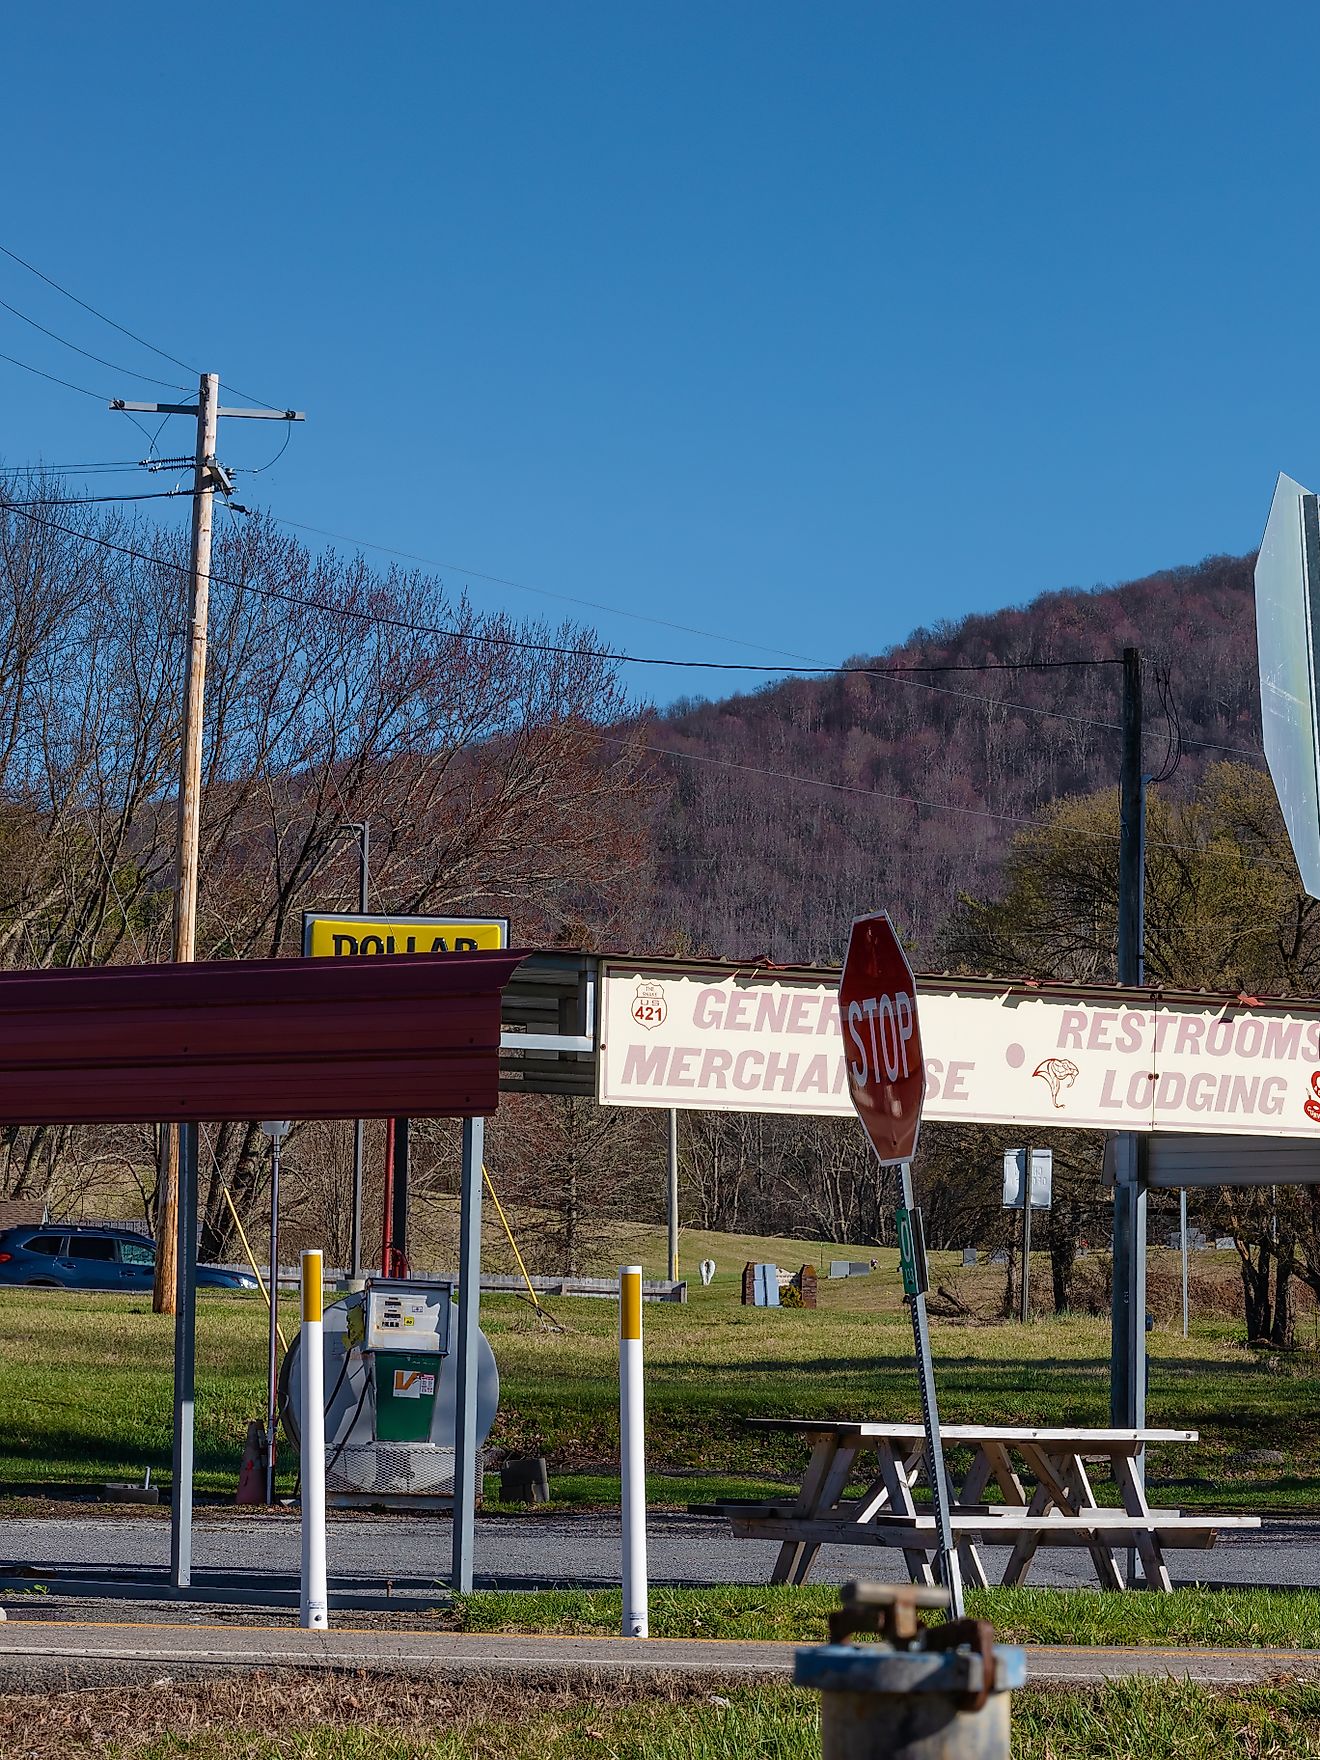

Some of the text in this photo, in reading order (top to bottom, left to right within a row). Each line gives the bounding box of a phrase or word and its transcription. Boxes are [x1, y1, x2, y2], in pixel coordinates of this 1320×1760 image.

[635, 1006, 662, 1022] 421
[640, 999, 660, 1007] US
[692, 988, 842, 1036] GENER
[849, 991, 914, 1087] STOP
[620, 1044, 975, 1100] MERCHASE
[1099, 1069, 1288, 1115] LODGING
